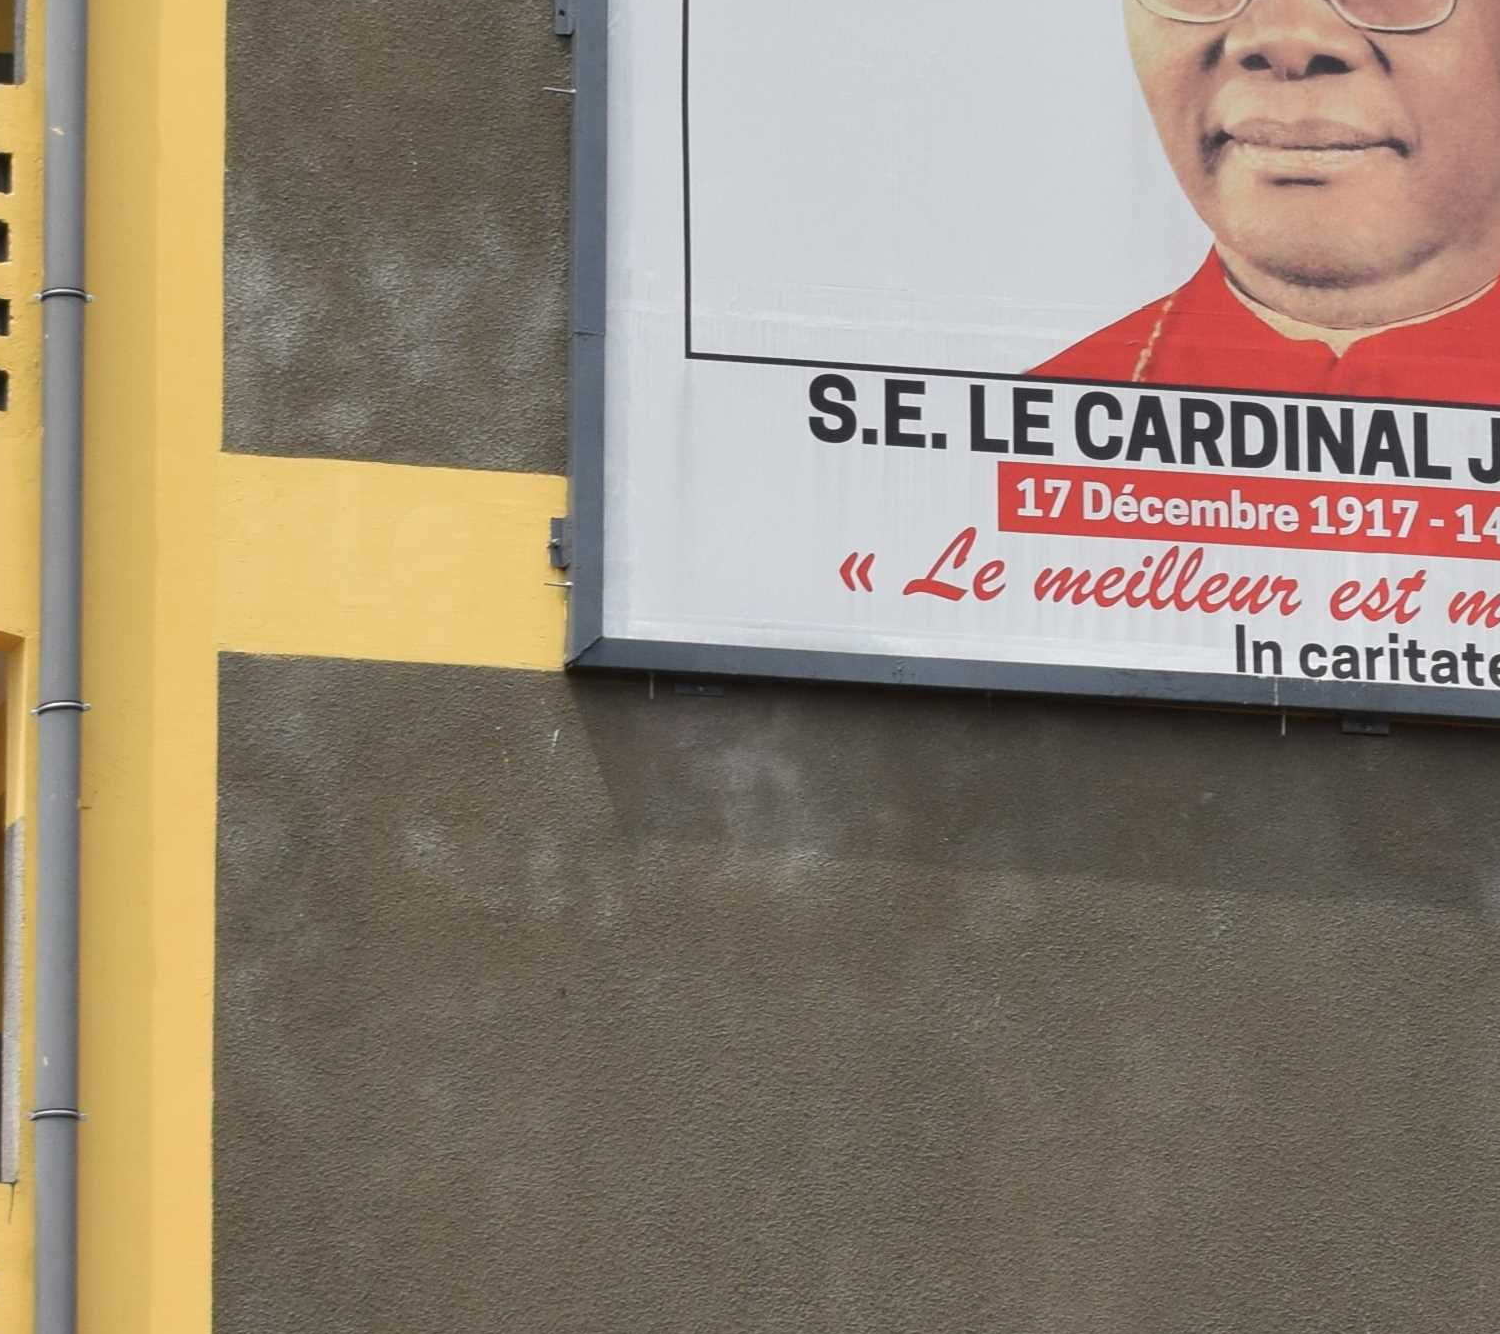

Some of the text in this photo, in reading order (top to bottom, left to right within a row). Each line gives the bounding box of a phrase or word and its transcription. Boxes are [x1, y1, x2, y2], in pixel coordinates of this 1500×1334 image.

[808, 373, 948, 450] S.E.
[970, 384, 1055, 456] LE
[1075, 390, 1453, 481] CARDINAL
[1016, 477, 1073, 518] 17
[1081, 481, 1300, 533] Décembre
[1309, 495, 1420, 539] 1917
[902, 526, 1007, 603] Le
[1032, 545, 1302, 617] meilleur
[1328, 569, 1427, 624] est
[1235, 624, 1283, 676] In
